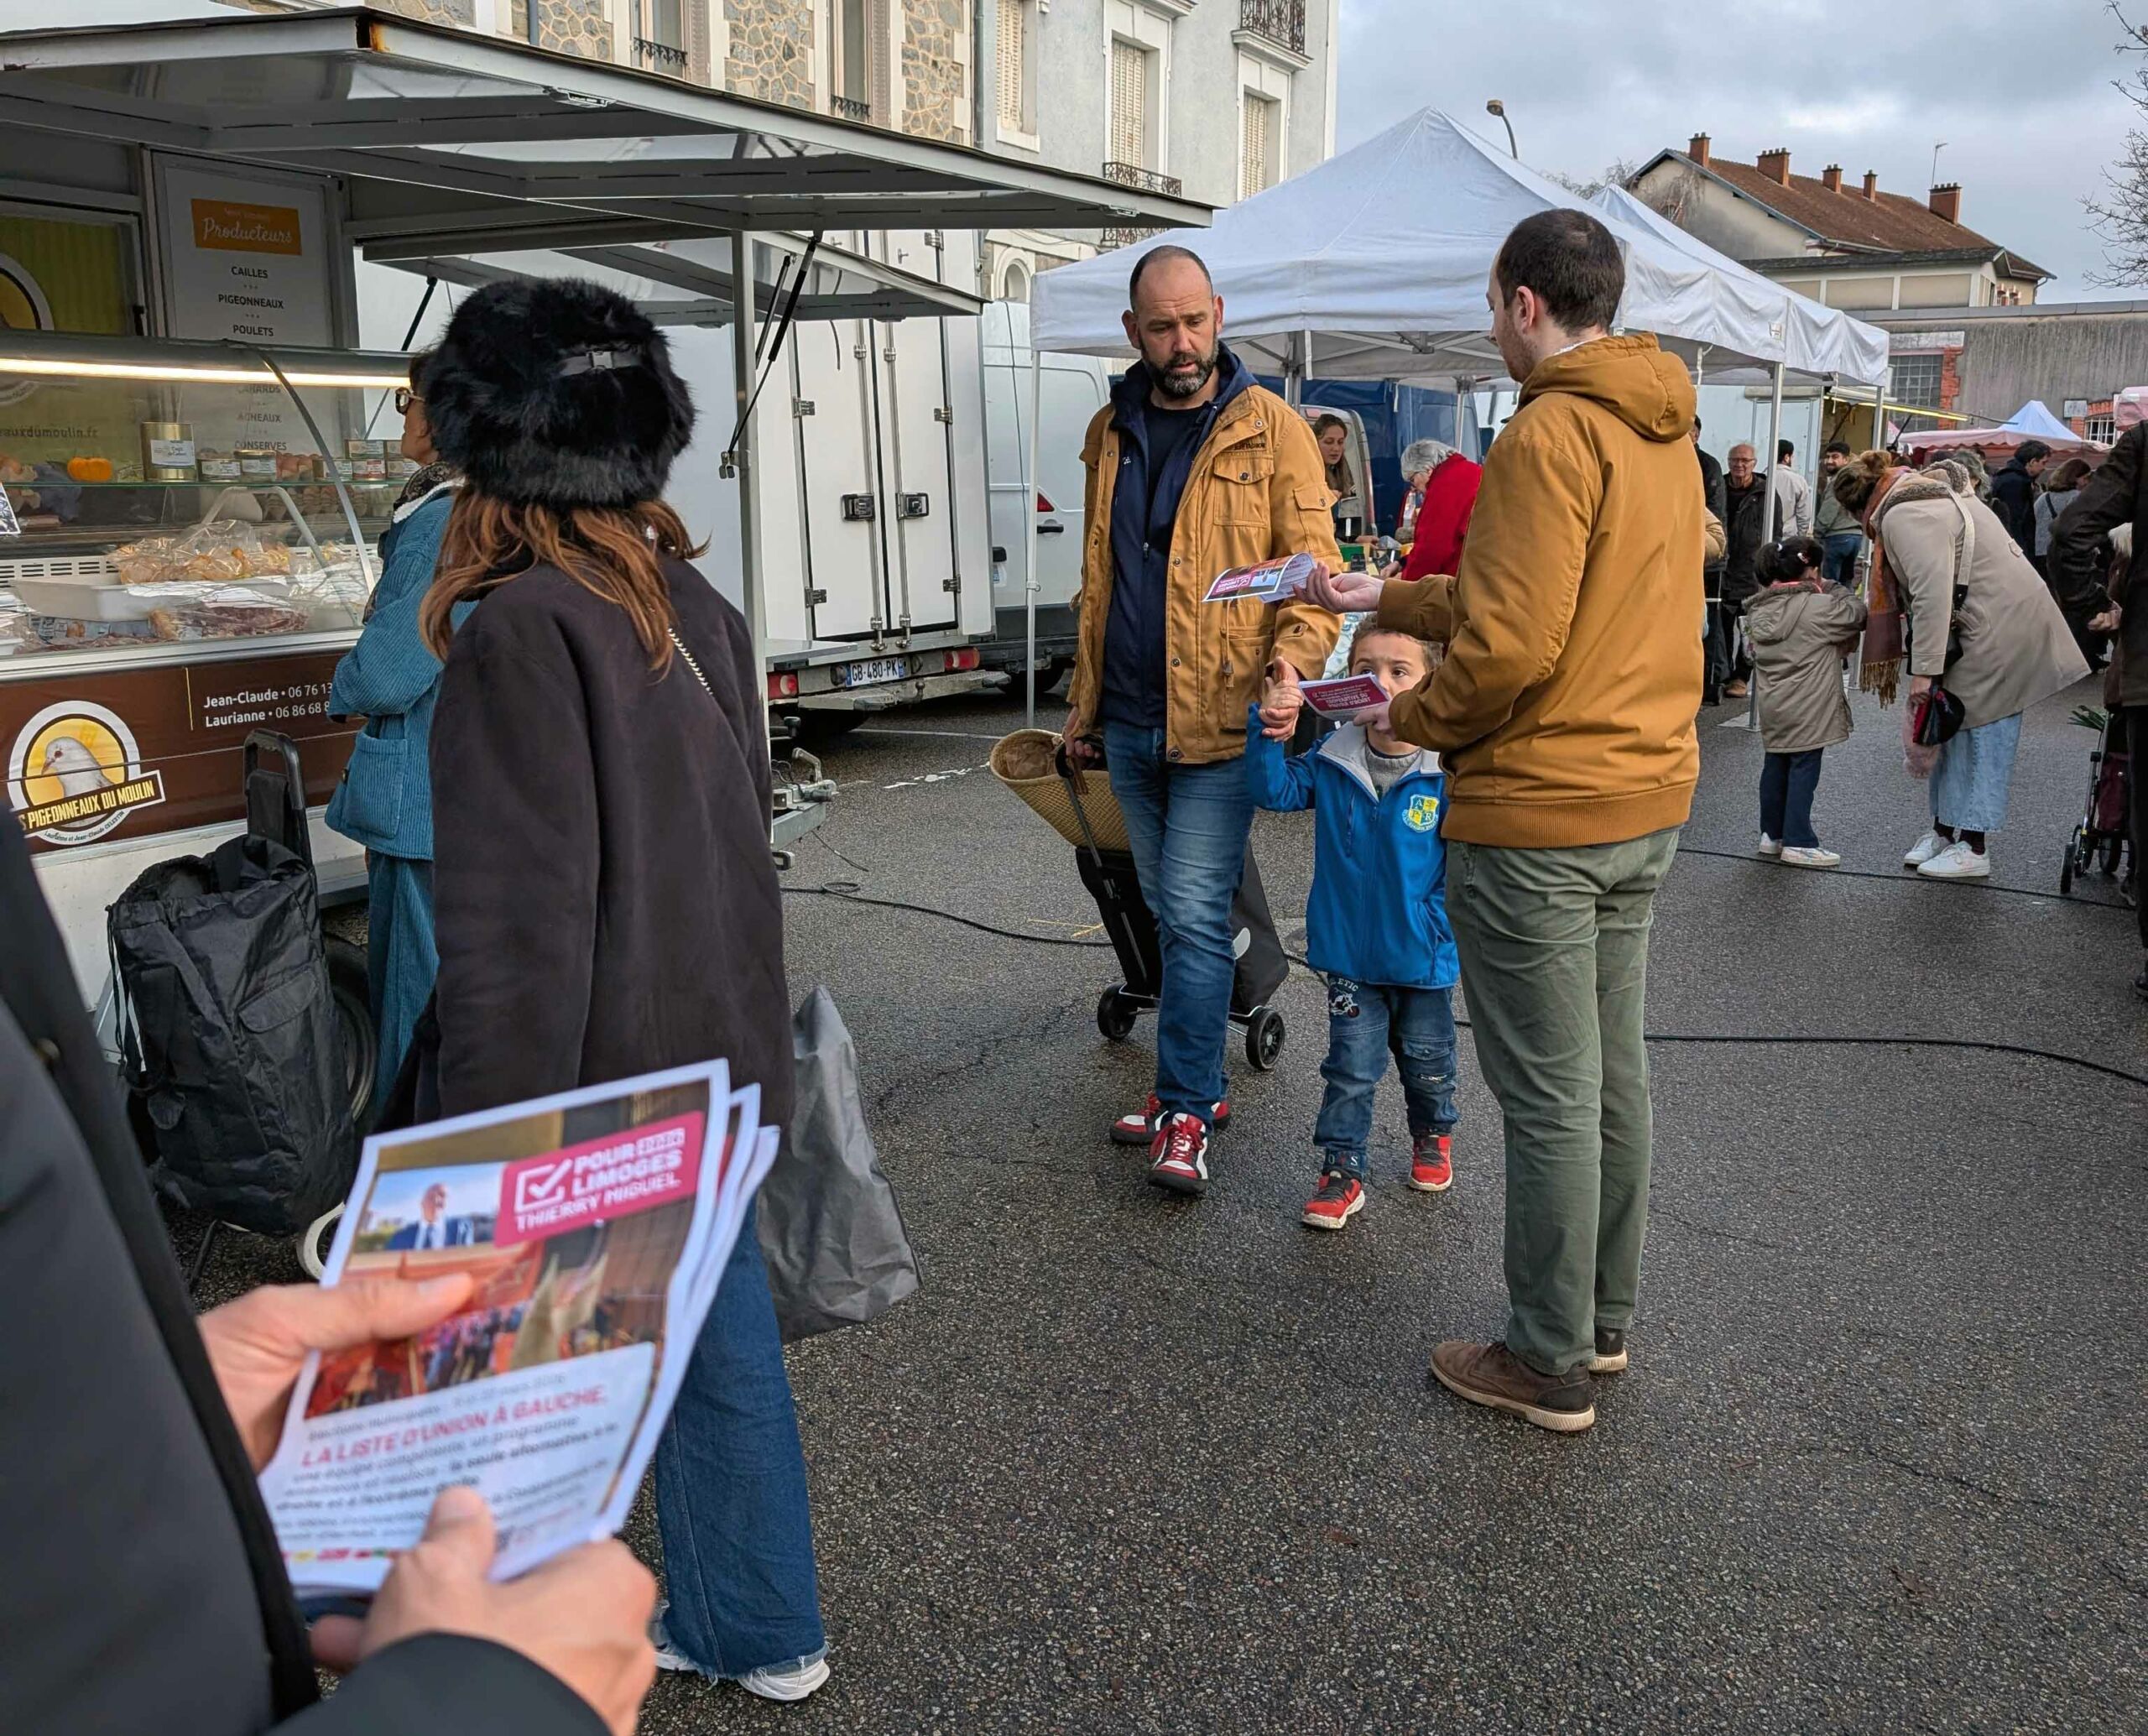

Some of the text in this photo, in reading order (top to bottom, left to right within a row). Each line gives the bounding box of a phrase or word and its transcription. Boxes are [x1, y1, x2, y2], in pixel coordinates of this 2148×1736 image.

[201, 217, 293, 243] Producteurs
[231, 266, 268, 279] CAILLES
[218, 294, 284, 309] PIGEONNEAUX
[233, 324, 274, 336] POULETS
[234, 441, 287, 451] CONSERVES
[852, 659, 898, 681] GB-480-PK
[204, 688, 279, 708] Jean-Claude
[288, 686, 302, 698] 06
[305, 684, 318, 696] 76
[206, 711, 266, 727] Laurianne
[275, 706, 289, 718] 06
[292, 704, 305, 717] 86
[308, 702, 321, 714] 68
[28, 795, 102, 829] PIGEONNEAUX
[102, 790, 117, 810] DU
[117, 780, 155, 805] MOULIN
[573, 1143, 636, 1174] POUR
[572, 1149, 683, 1196] LIMOGES
[517, 1171, 680, 1232] THIERRY MIGUEL
[302, 1447, 332, 1467] LA
[337, 1435, 398, 1462] LISTE
[403, 1410, 487, 1446] D'UNION
